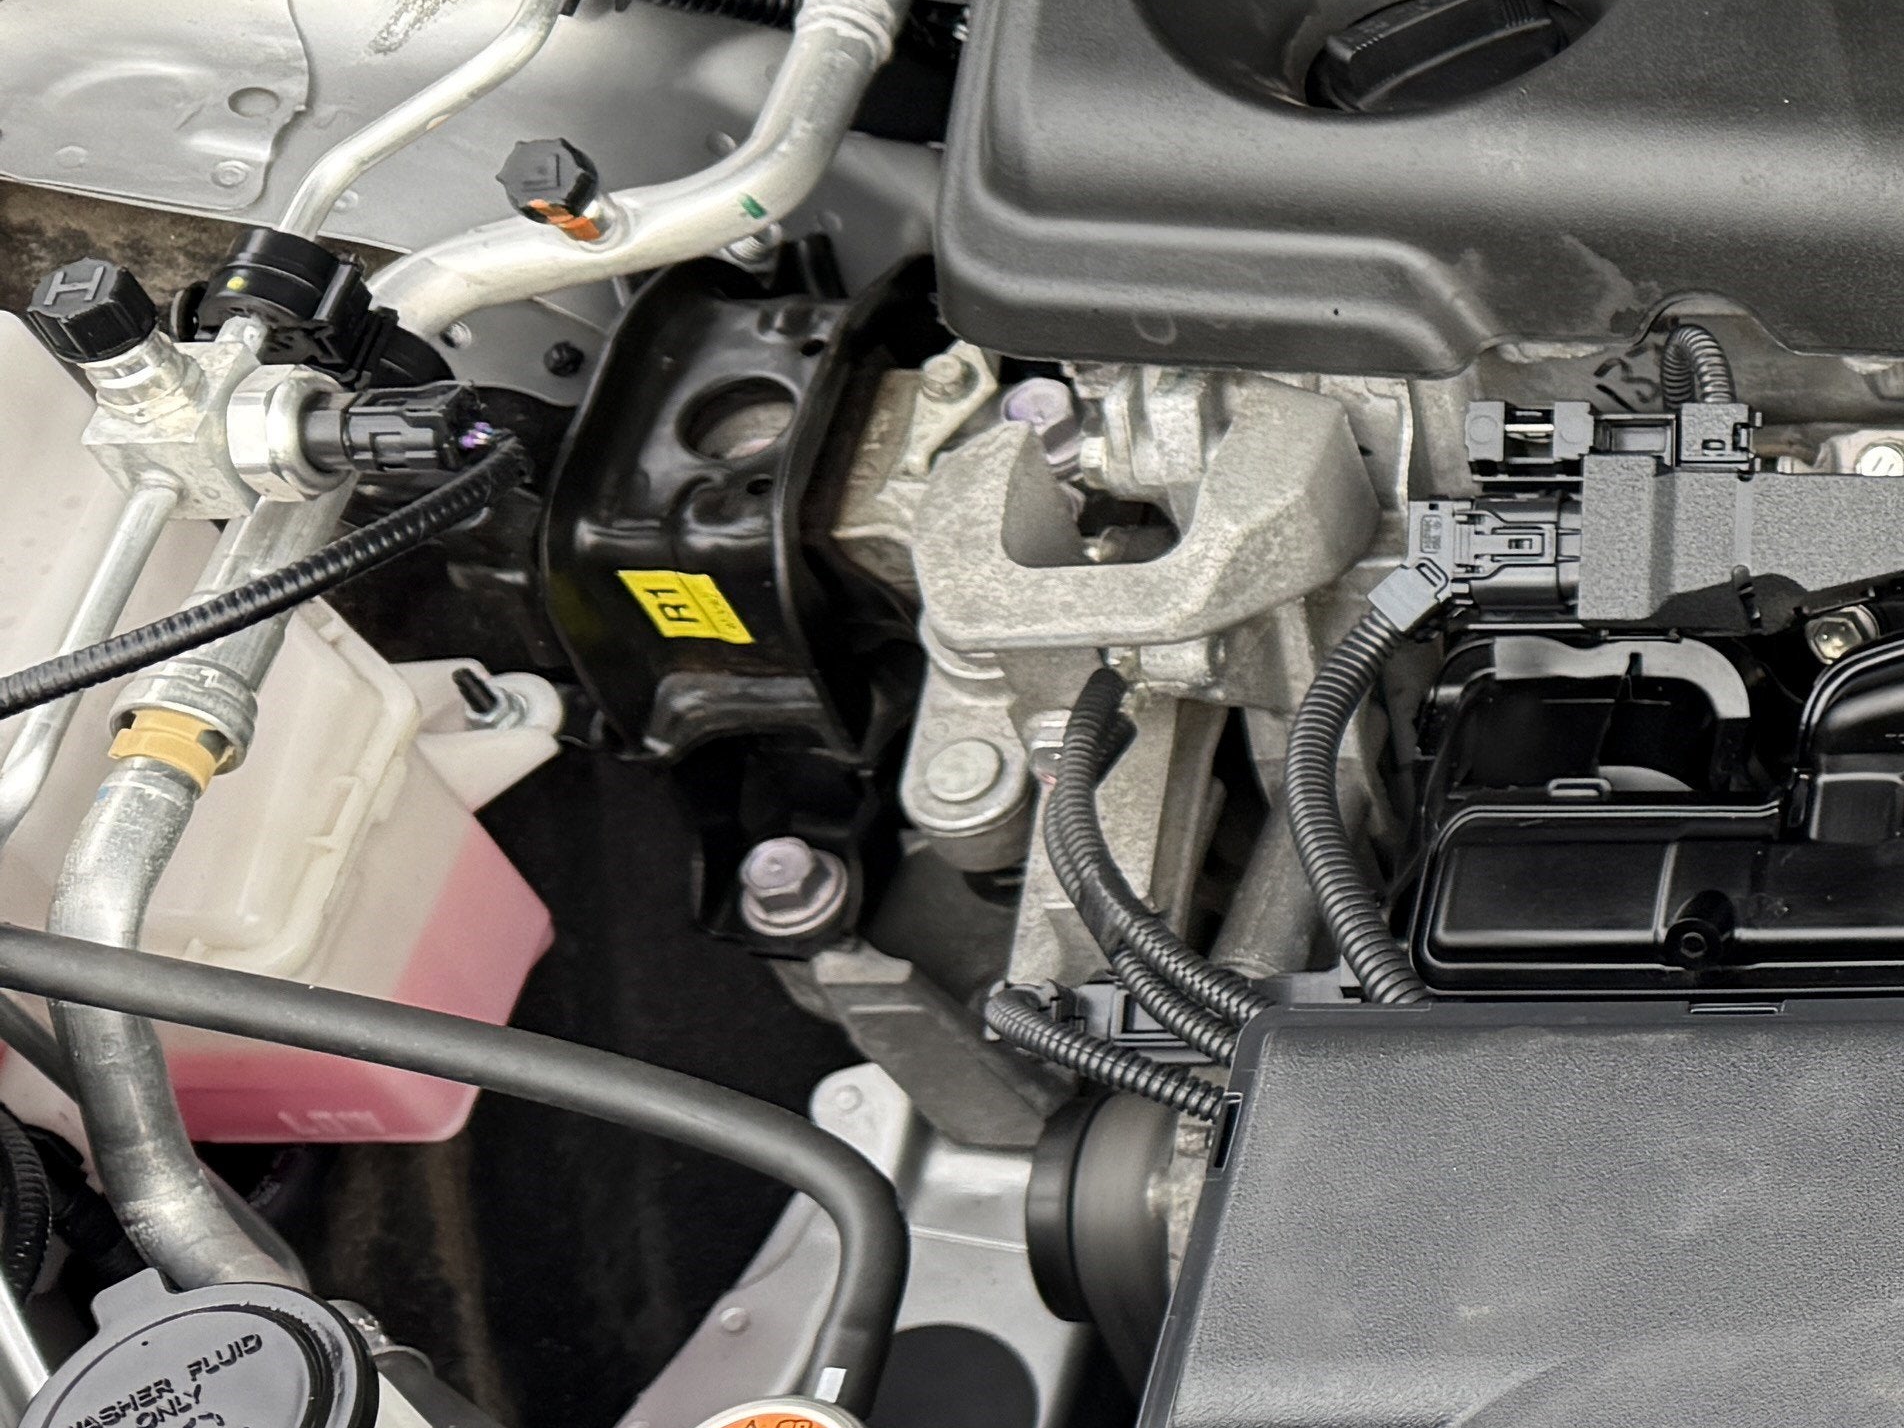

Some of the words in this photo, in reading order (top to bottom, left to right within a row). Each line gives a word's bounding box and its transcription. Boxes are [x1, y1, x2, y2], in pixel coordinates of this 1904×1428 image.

[42, 265, 105, 307] H
[643, 588, 699, 622] R1
[186, 1333, 264, 1382] FLUID
